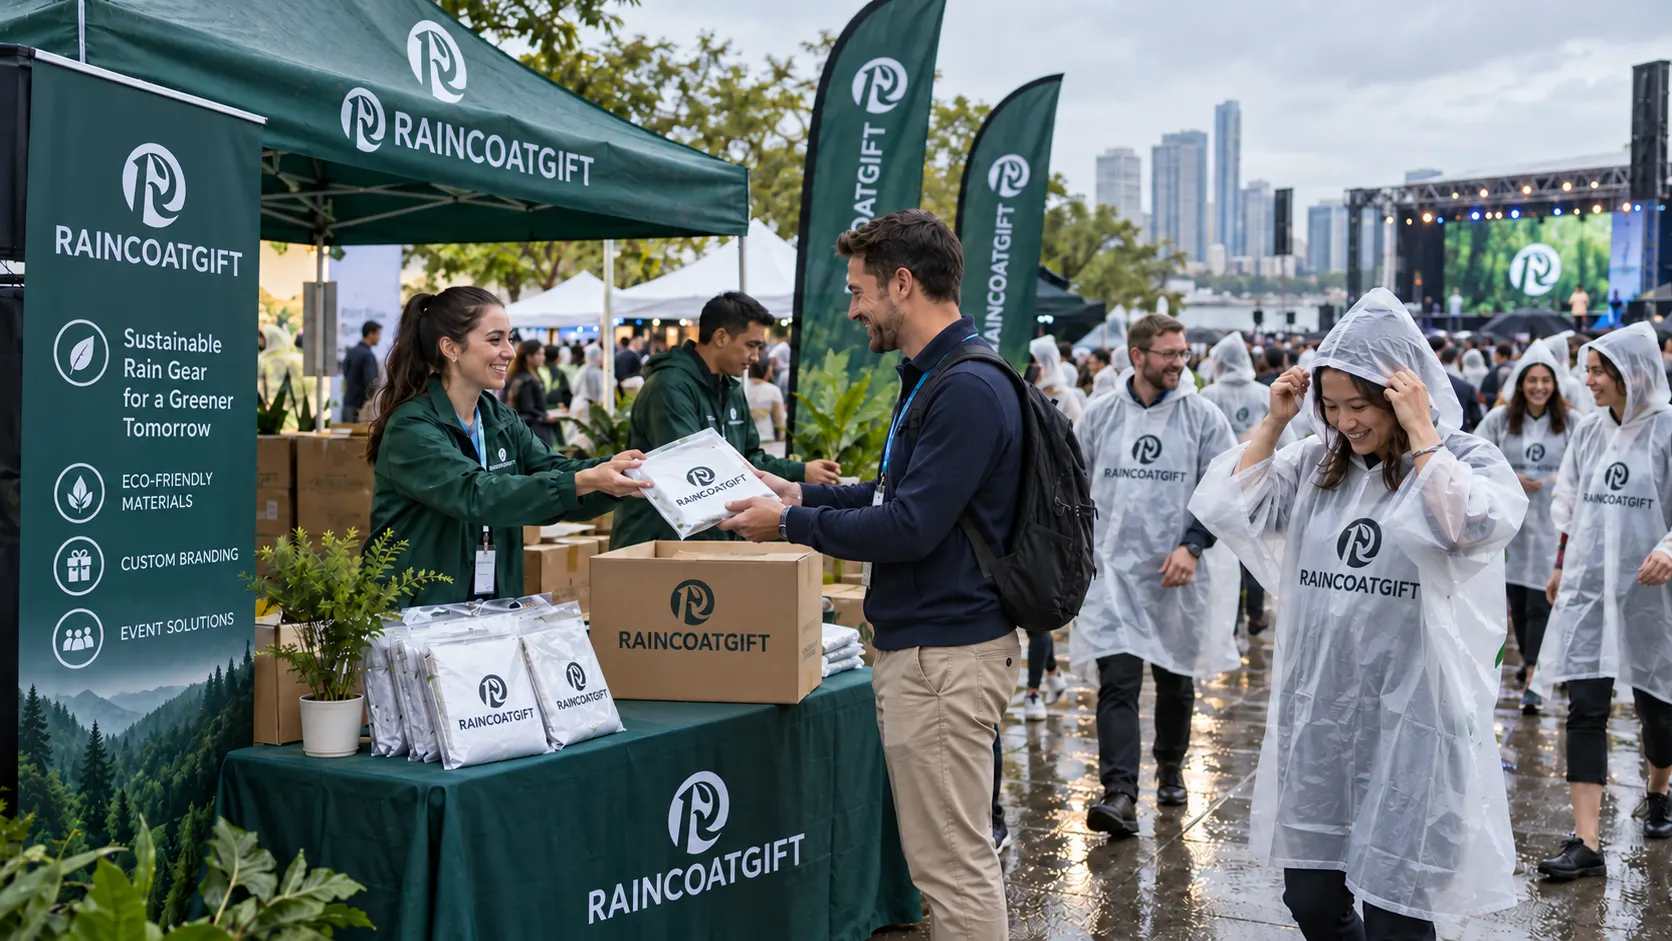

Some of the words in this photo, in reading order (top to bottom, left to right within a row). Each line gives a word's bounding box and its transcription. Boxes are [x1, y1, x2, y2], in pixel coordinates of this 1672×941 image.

[394, 112, 595, 186] RAINCOATGIFT
[55, 225, 243, 277] RAINCOATGIFT
[124, 328, 222, 354] Sustainable
[124, 358, 162, 380] Rain
[167, 361, 208, 381] Gear
[123, 387, 149, 409] for
[154, 394, 164, 409] a
[169, 390, 234, 410] Greener
[123, 418, 211, 438] Tomorrow
[122, 471, 213, 489] ECO-FRIENDLY
[1104, 467, 1187, 483] RAINCOATGIFT
[676, 474, 747, 507] RAINCOATGIFT
[1584, 493, 1655, 509] RAINCOATGIFT
[122, 494, 193, 511] MATERIALS
[121, 552, 175, 571] CUSTOM
[179, 548, 239, 566] BRANDING
[1300, 569, 1420, 600] RAINCOATGIFT
[121, 621, 163, 641] EVENT
[166, 612, 234, 634] SOLUTIONS
[618, 631, 771, 652] RAINCOATGIFT
[459, 708, 534, 731] RAINCOATGIFT
[588, 833, 805, 924] RAINCOATGIFT
